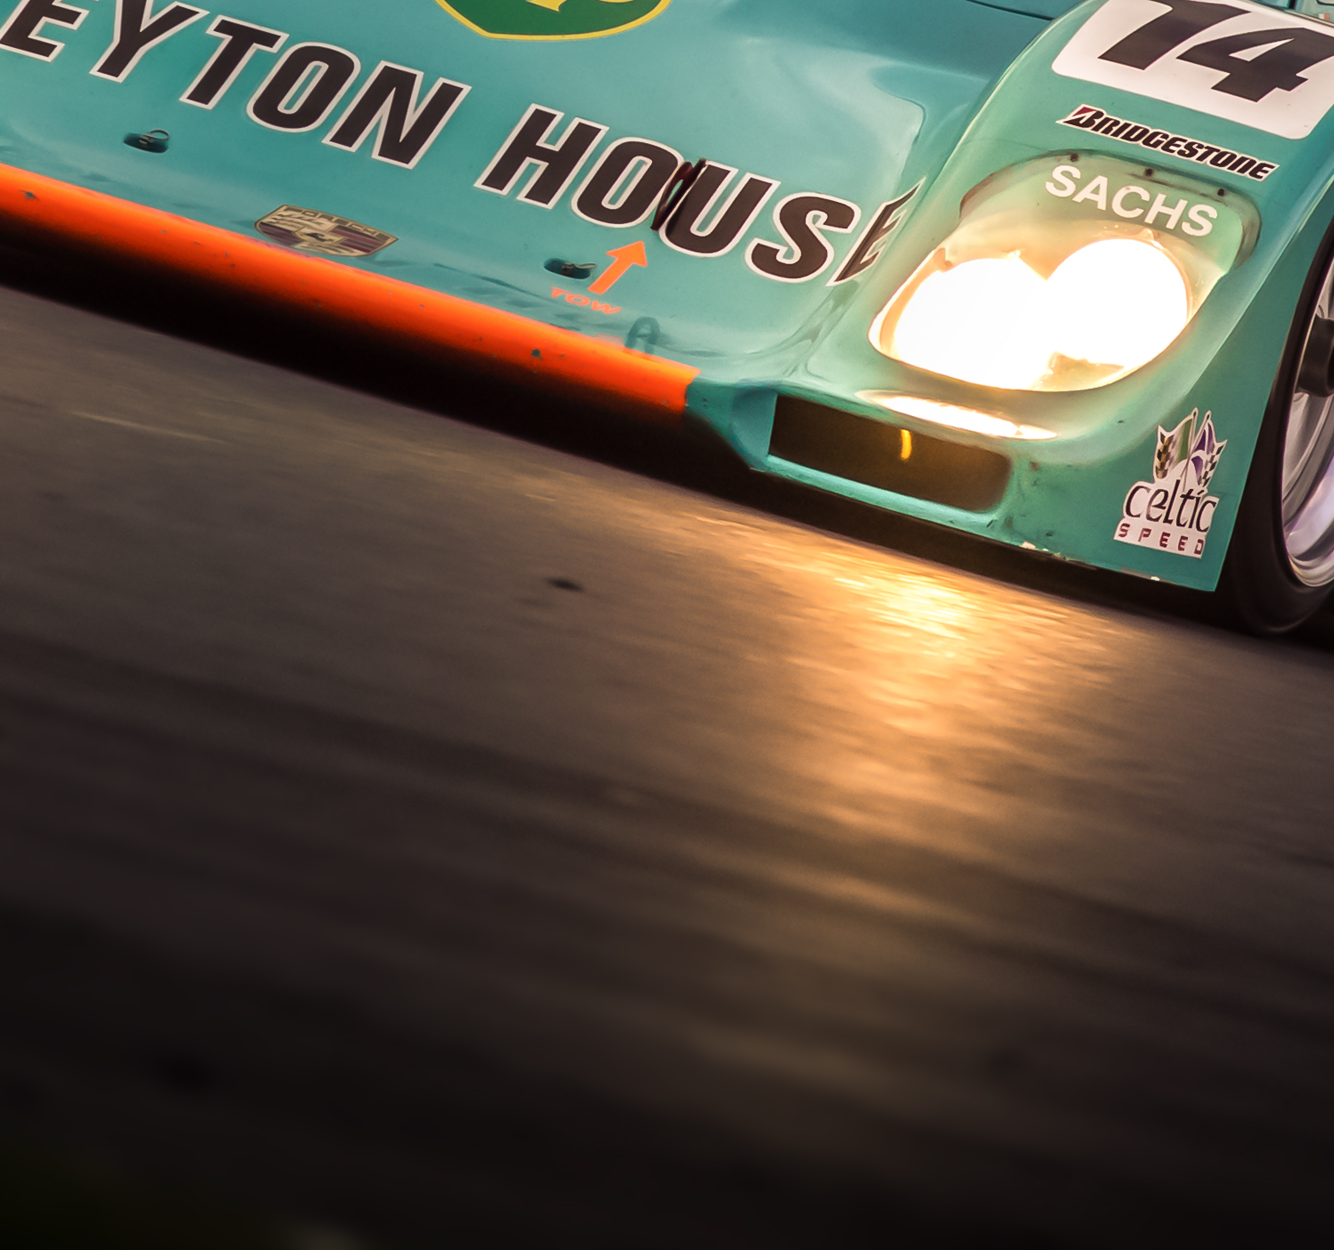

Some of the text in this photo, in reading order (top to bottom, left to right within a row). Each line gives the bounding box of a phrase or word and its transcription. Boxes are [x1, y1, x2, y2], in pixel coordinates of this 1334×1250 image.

[1060, 105, 1278, 181] BRIDGESTONE
[473, 103, 926, 287] HOUSE
[1044, 164, 1219, 238] SACHS
[550, 286, 622, 315] TOW
[1119, 522, 1205, 555] SPEED
